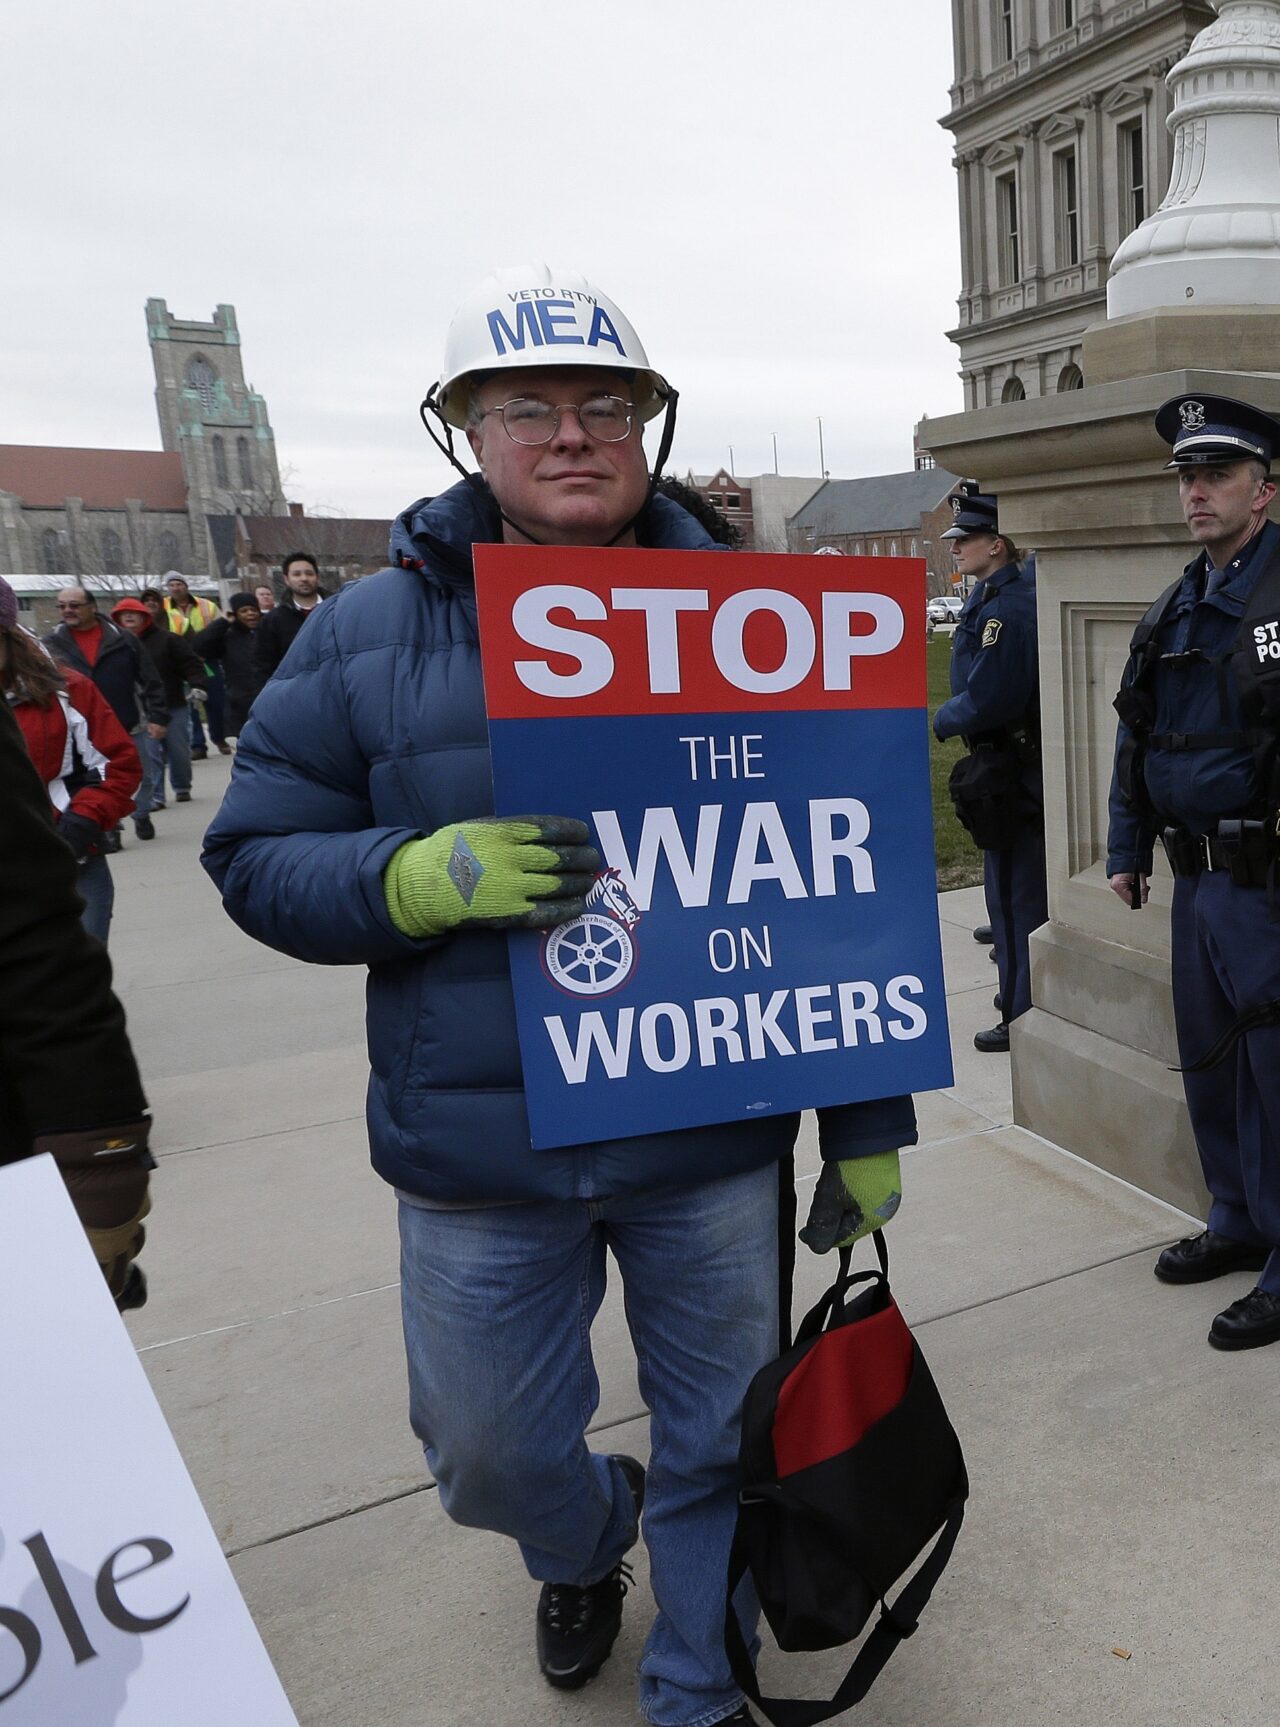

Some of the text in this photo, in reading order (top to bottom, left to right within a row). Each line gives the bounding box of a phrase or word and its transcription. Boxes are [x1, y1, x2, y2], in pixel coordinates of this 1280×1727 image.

[507, 287, 597, 306] VETO RTW
[486, 300, 628, 357] MEA
[511, 583, 905, 699] STOP
[679, 734, 765, 780] THE
[592, 797, 877, 912] WAR
[549, 929, 564, 975] International
[565, 916, 613, 929] Brotherhood
[612, 925, 620, 934] of
[708, 925, 772, 973] ON
[543, 975, 928, 1085] WORKERS
